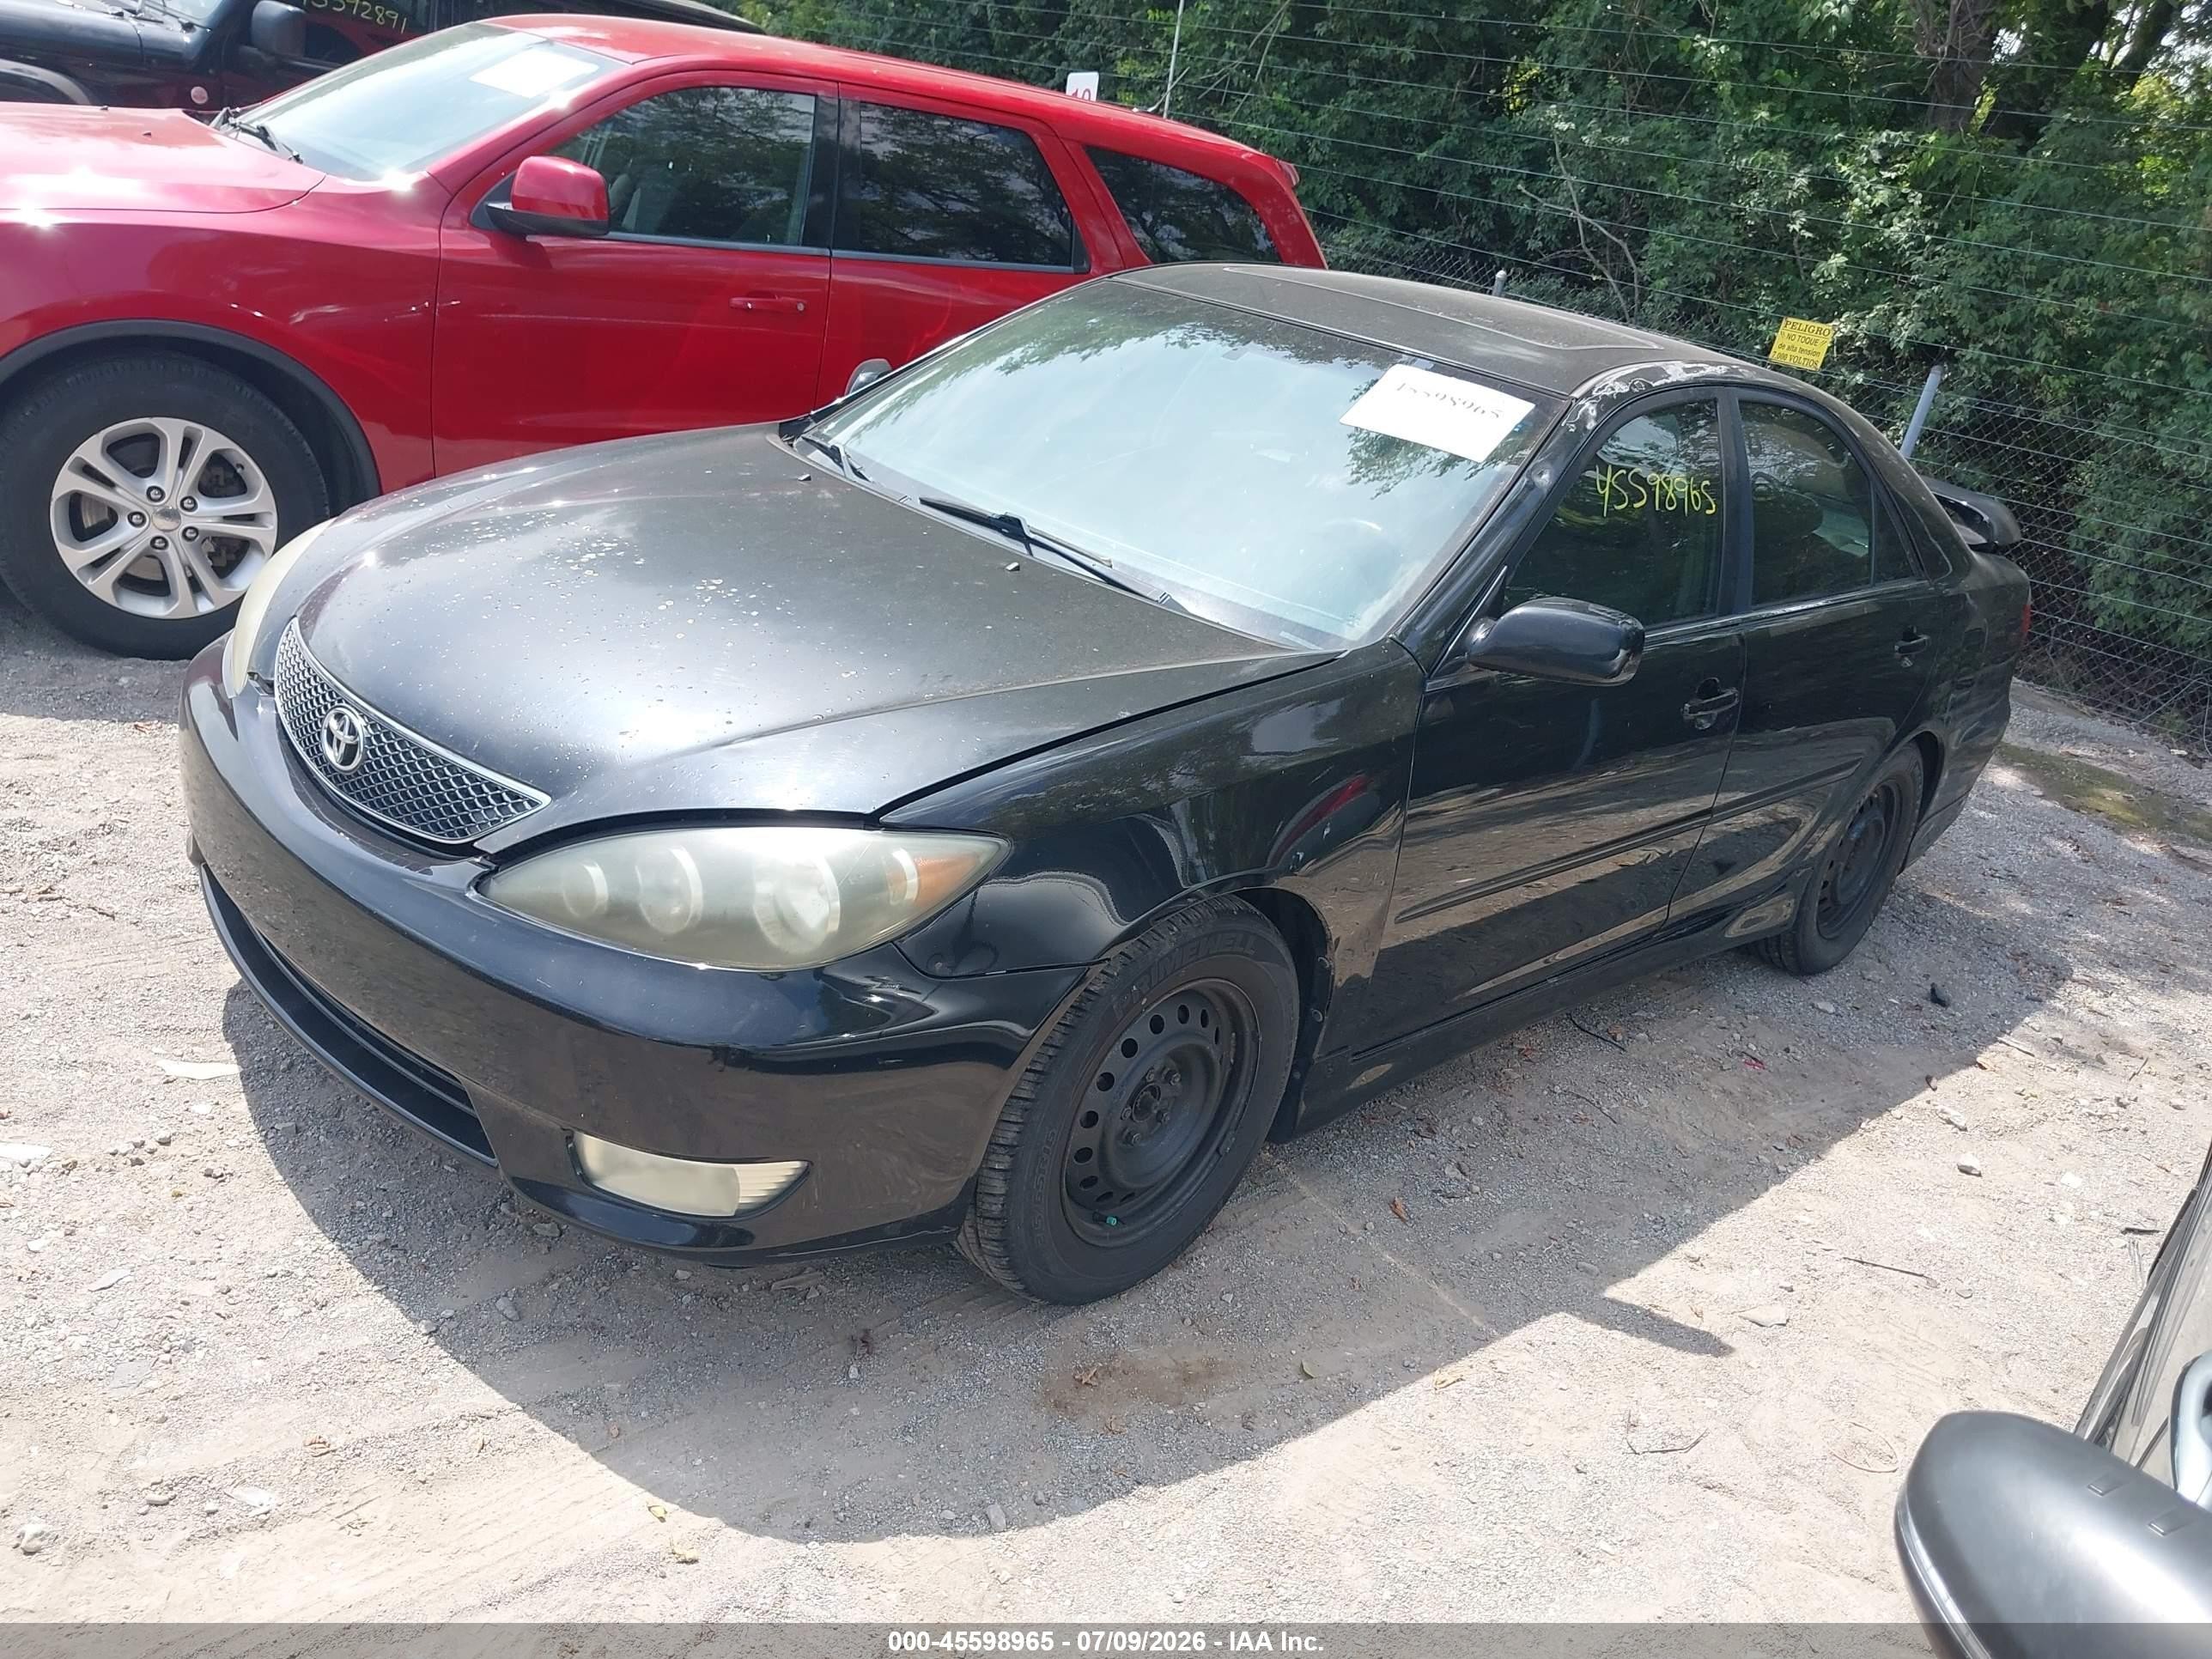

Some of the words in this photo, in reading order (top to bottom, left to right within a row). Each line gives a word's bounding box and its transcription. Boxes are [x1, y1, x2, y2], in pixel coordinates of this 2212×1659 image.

[1784, 320, 1831, 337] PELIGRO
[1786, 333, 1796, 342] NO
[1797, 335, 1820, 346] TOQUE
[1790, 355, 1820, 368] VOLTIOS
[1595, 464, 1717, 518] 45598965
